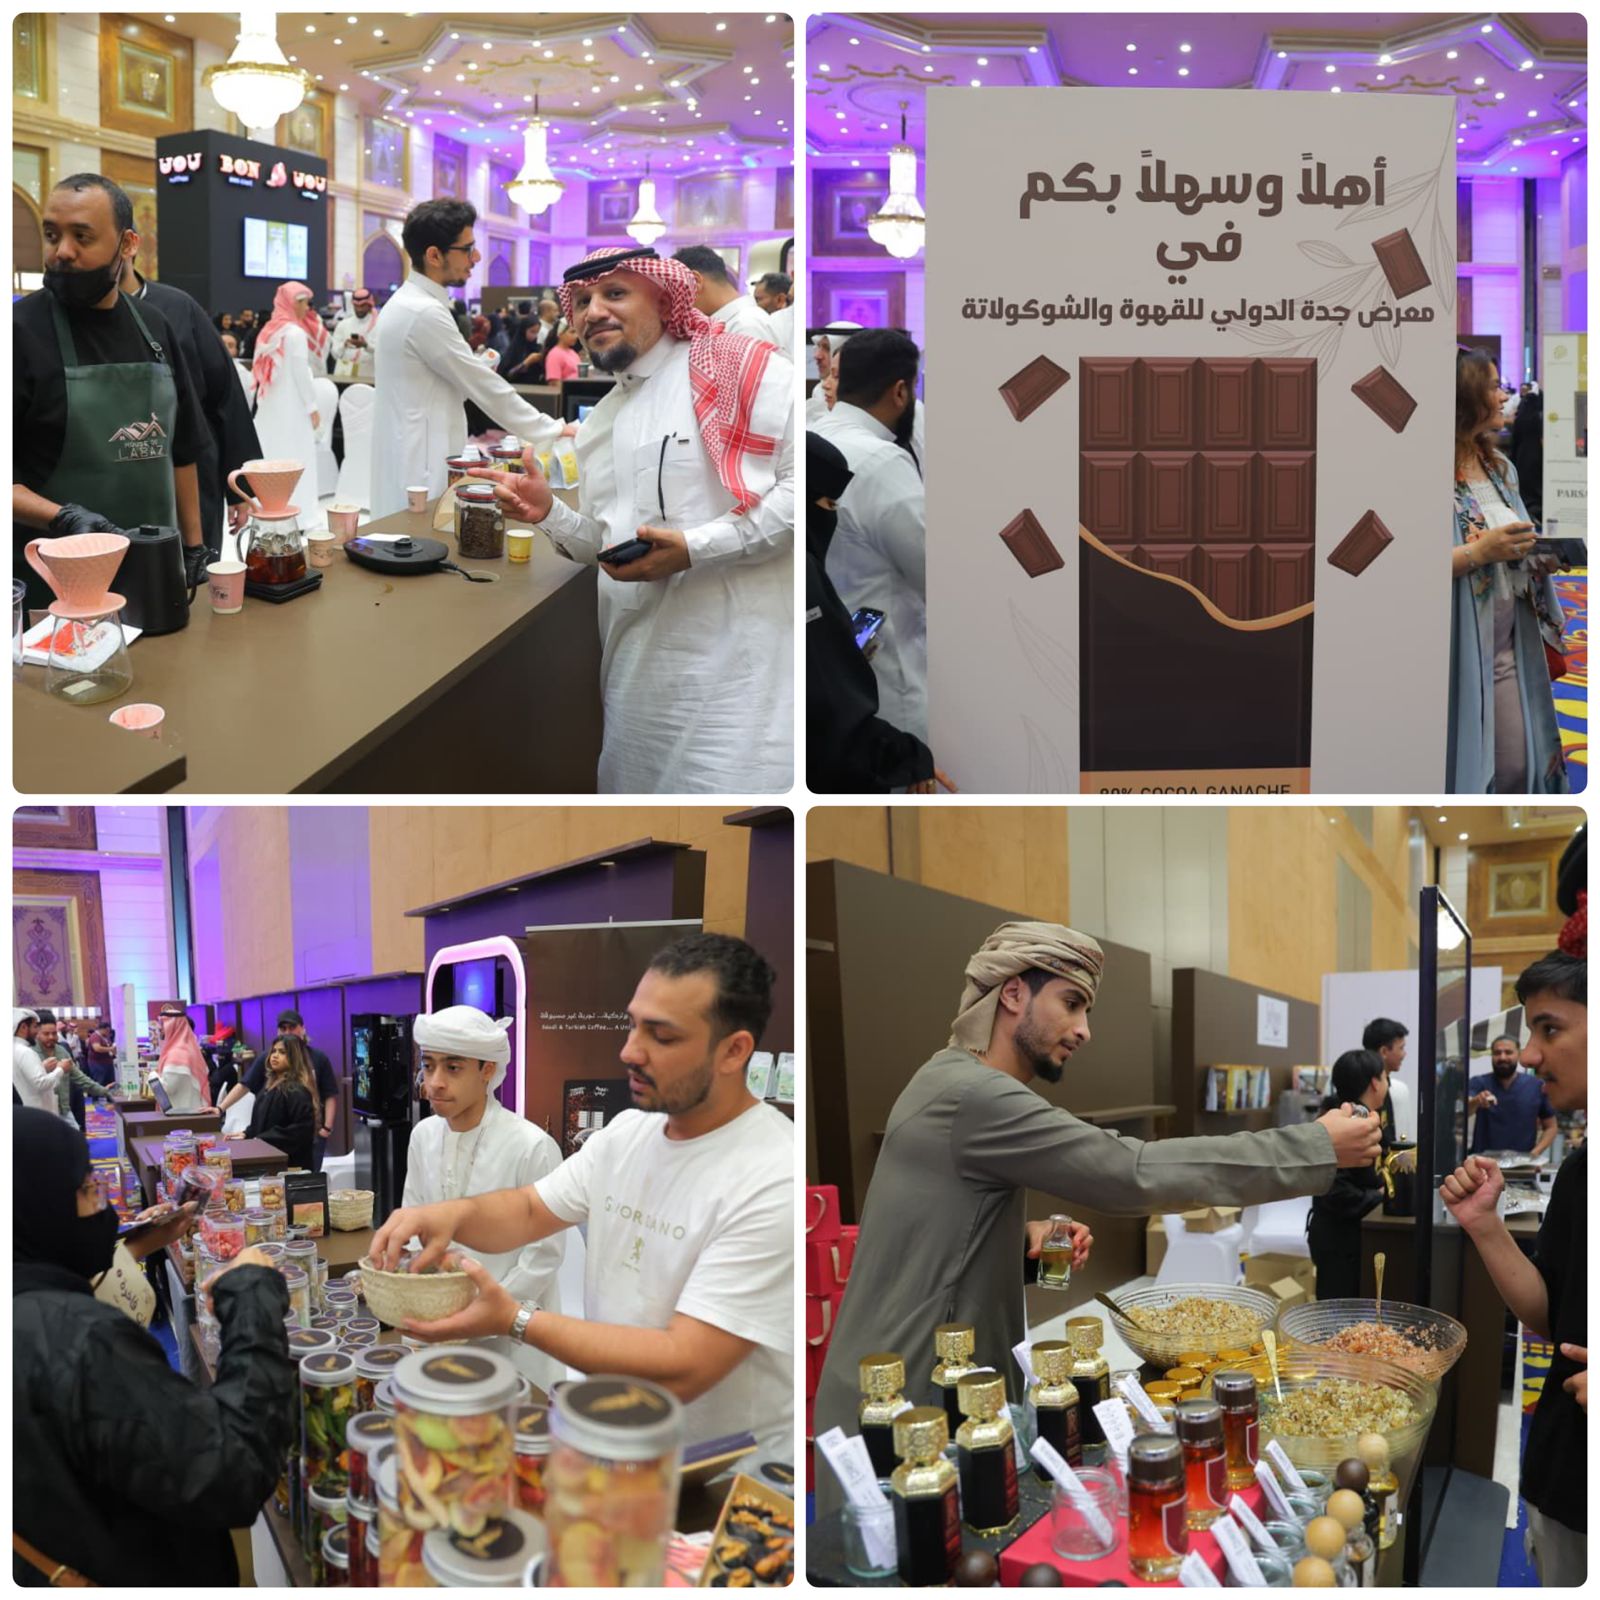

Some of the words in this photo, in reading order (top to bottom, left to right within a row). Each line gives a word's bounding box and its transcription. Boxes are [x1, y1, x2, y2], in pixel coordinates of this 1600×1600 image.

[219, 154, 261, 180] BON
[1019, 162, 1121, 220] بكم
[1156, 220, 1242, 285] في
[961, 294, 1113, 327] والشوكولاتة
[1119, 297, 1204, 327] للقهوة
[1210, 298, 1295, 332] الدولي
[1300, 298, 1351, 322] جدة
[1357, 300, 1435, 329] معرض
[1206, 784, 1291, 795] GANACHE
